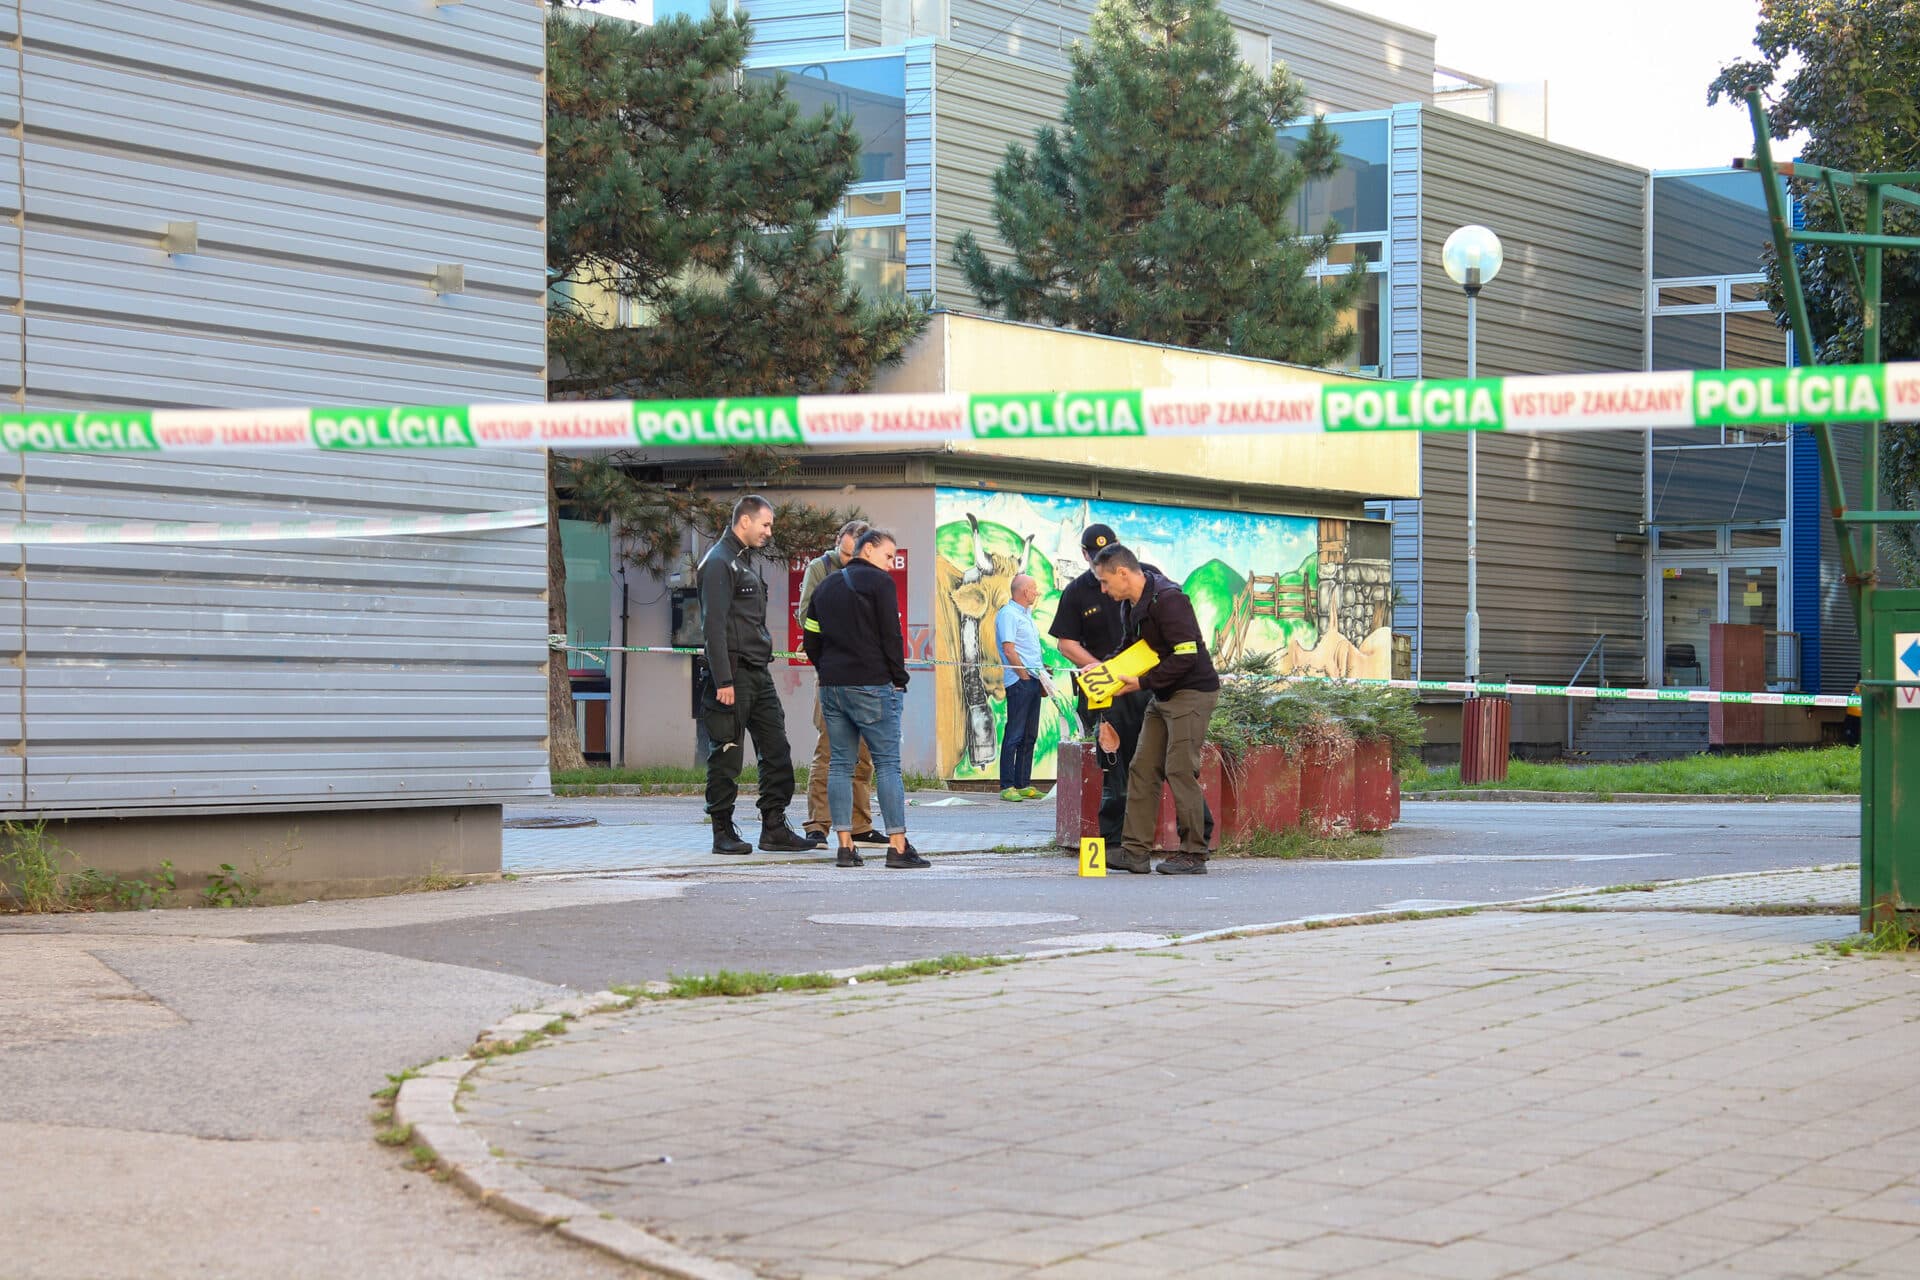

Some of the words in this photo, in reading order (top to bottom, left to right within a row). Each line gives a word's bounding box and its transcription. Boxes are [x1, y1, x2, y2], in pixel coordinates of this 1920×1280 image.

[3, 412, 154, 449] POLÍCIA
[315, 408, 469, 445] POLÍCIA
[638, 399, 797, 441] POLÍCIA
[806, 412, 864, 434] VSTUP
[974, 392, 1139, 436] POLÍCIA
[1149, 403, 1211, 427] VSTUP
[1217, 395, 1314, 425] ZAKÁZANÝ
[1326, 382, 1499, 428] POLÍCIA
[1512, 392, 1576, 416] VSTUP
[1581, 384, 1685, 415] ZAKÁZANÝ
[1697, 368, 1880, 418] POLÍCIA
[1088, 841, 1100, 869] 2
